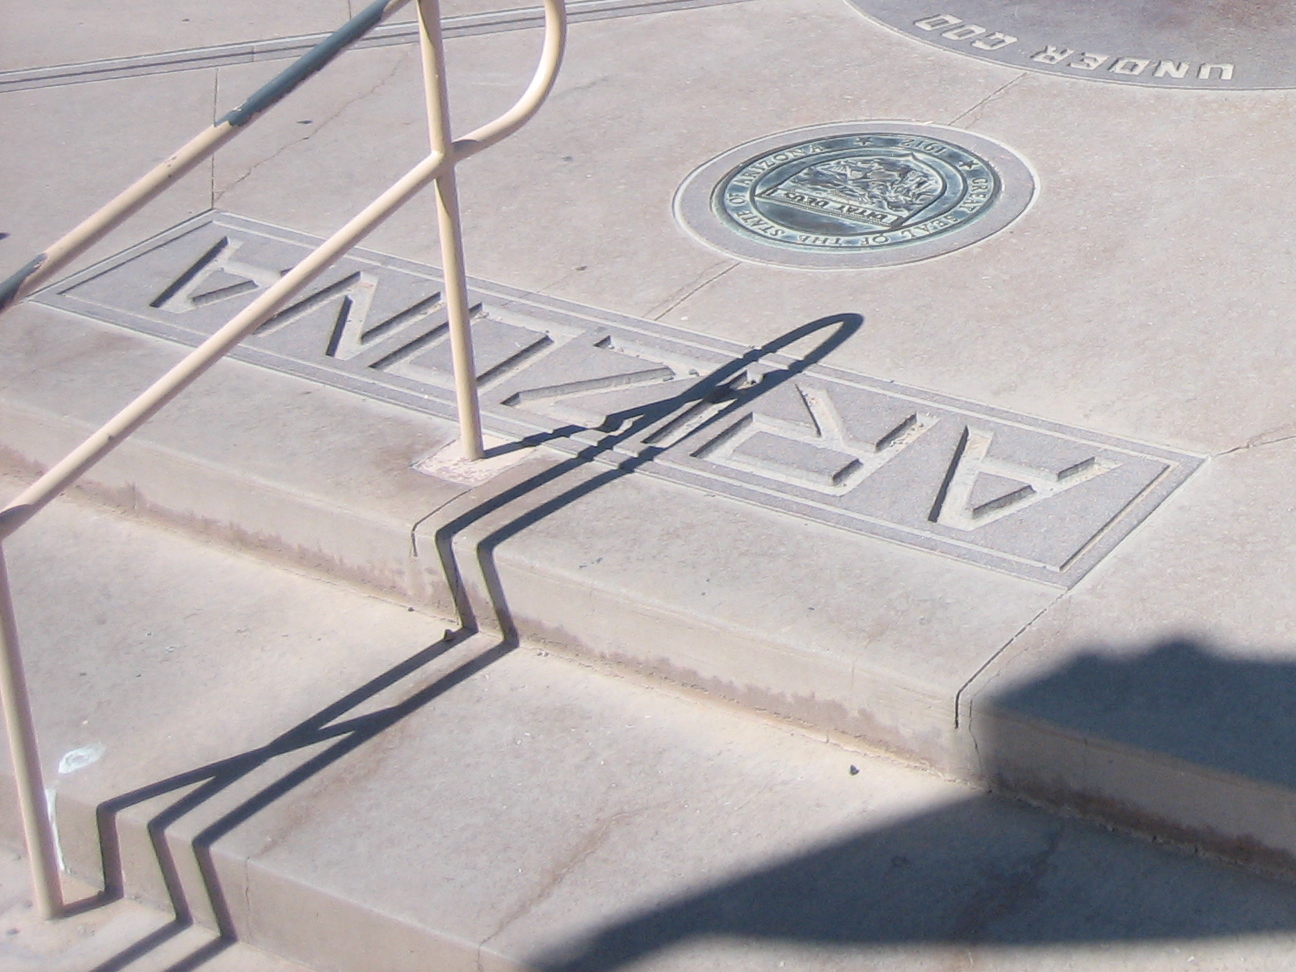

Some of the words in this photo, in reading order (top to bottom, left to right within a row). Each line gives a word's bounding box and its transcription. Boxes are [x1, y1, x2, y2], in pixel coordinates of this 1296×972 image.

[913, 14, 1019, 51] GOD
[1030, 45, 1235, 80] UNDER
[901, 138, 948, 154] 1912
[731, 144, 824, 187] ARIZONA
[728, 192, 746, 206] OF
[784, 192, 829, 208] DEUS
[959, 177, 990, 213] GREAT
[735, 210, 785, 237] STATE
[901, 214, 959, 234] SEAL
[799, 234, 841, 245] THE
[859, 228, 889, 245] OF
[149, 234, 1109, 530] ARIZONA
